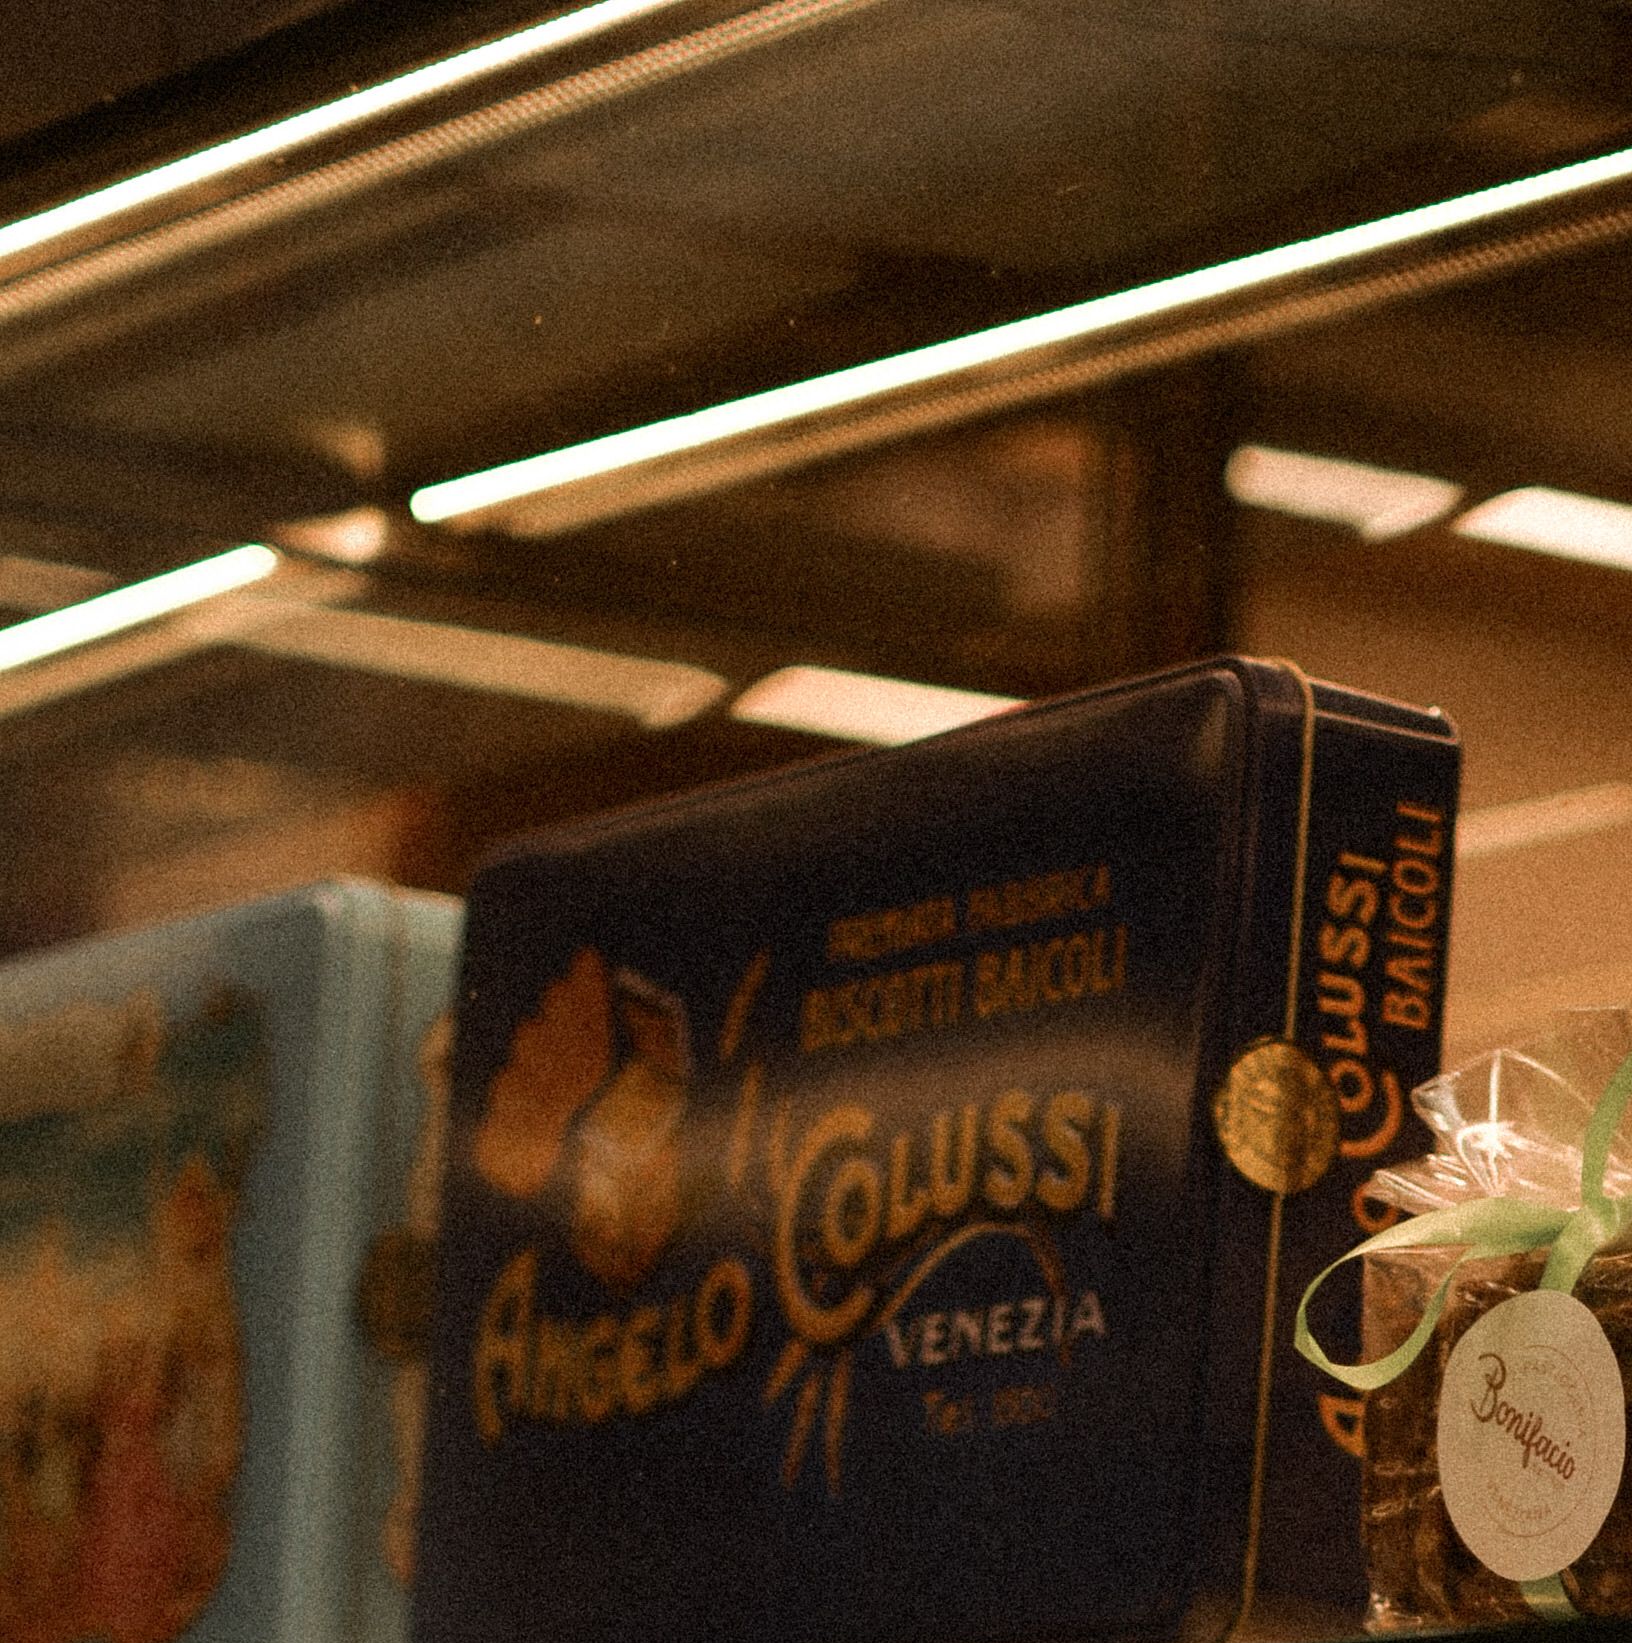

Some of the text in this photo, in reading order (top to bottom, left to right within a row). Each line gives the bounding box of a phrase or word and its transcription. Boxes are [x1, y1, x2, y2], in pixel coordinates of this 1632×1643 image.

[1316, 850, 1399, 1158] COLUSSI
[1382, 801, 1443, 1030] BAICOLI
[774, 1089, 1122, 1342] COLUSSI
[472, 1247, 752, 1450] ANGELO
[884, 1289, 1108, 1371] VENEZIA
[1470, 1352, 1577, 1481] Bonifacio
